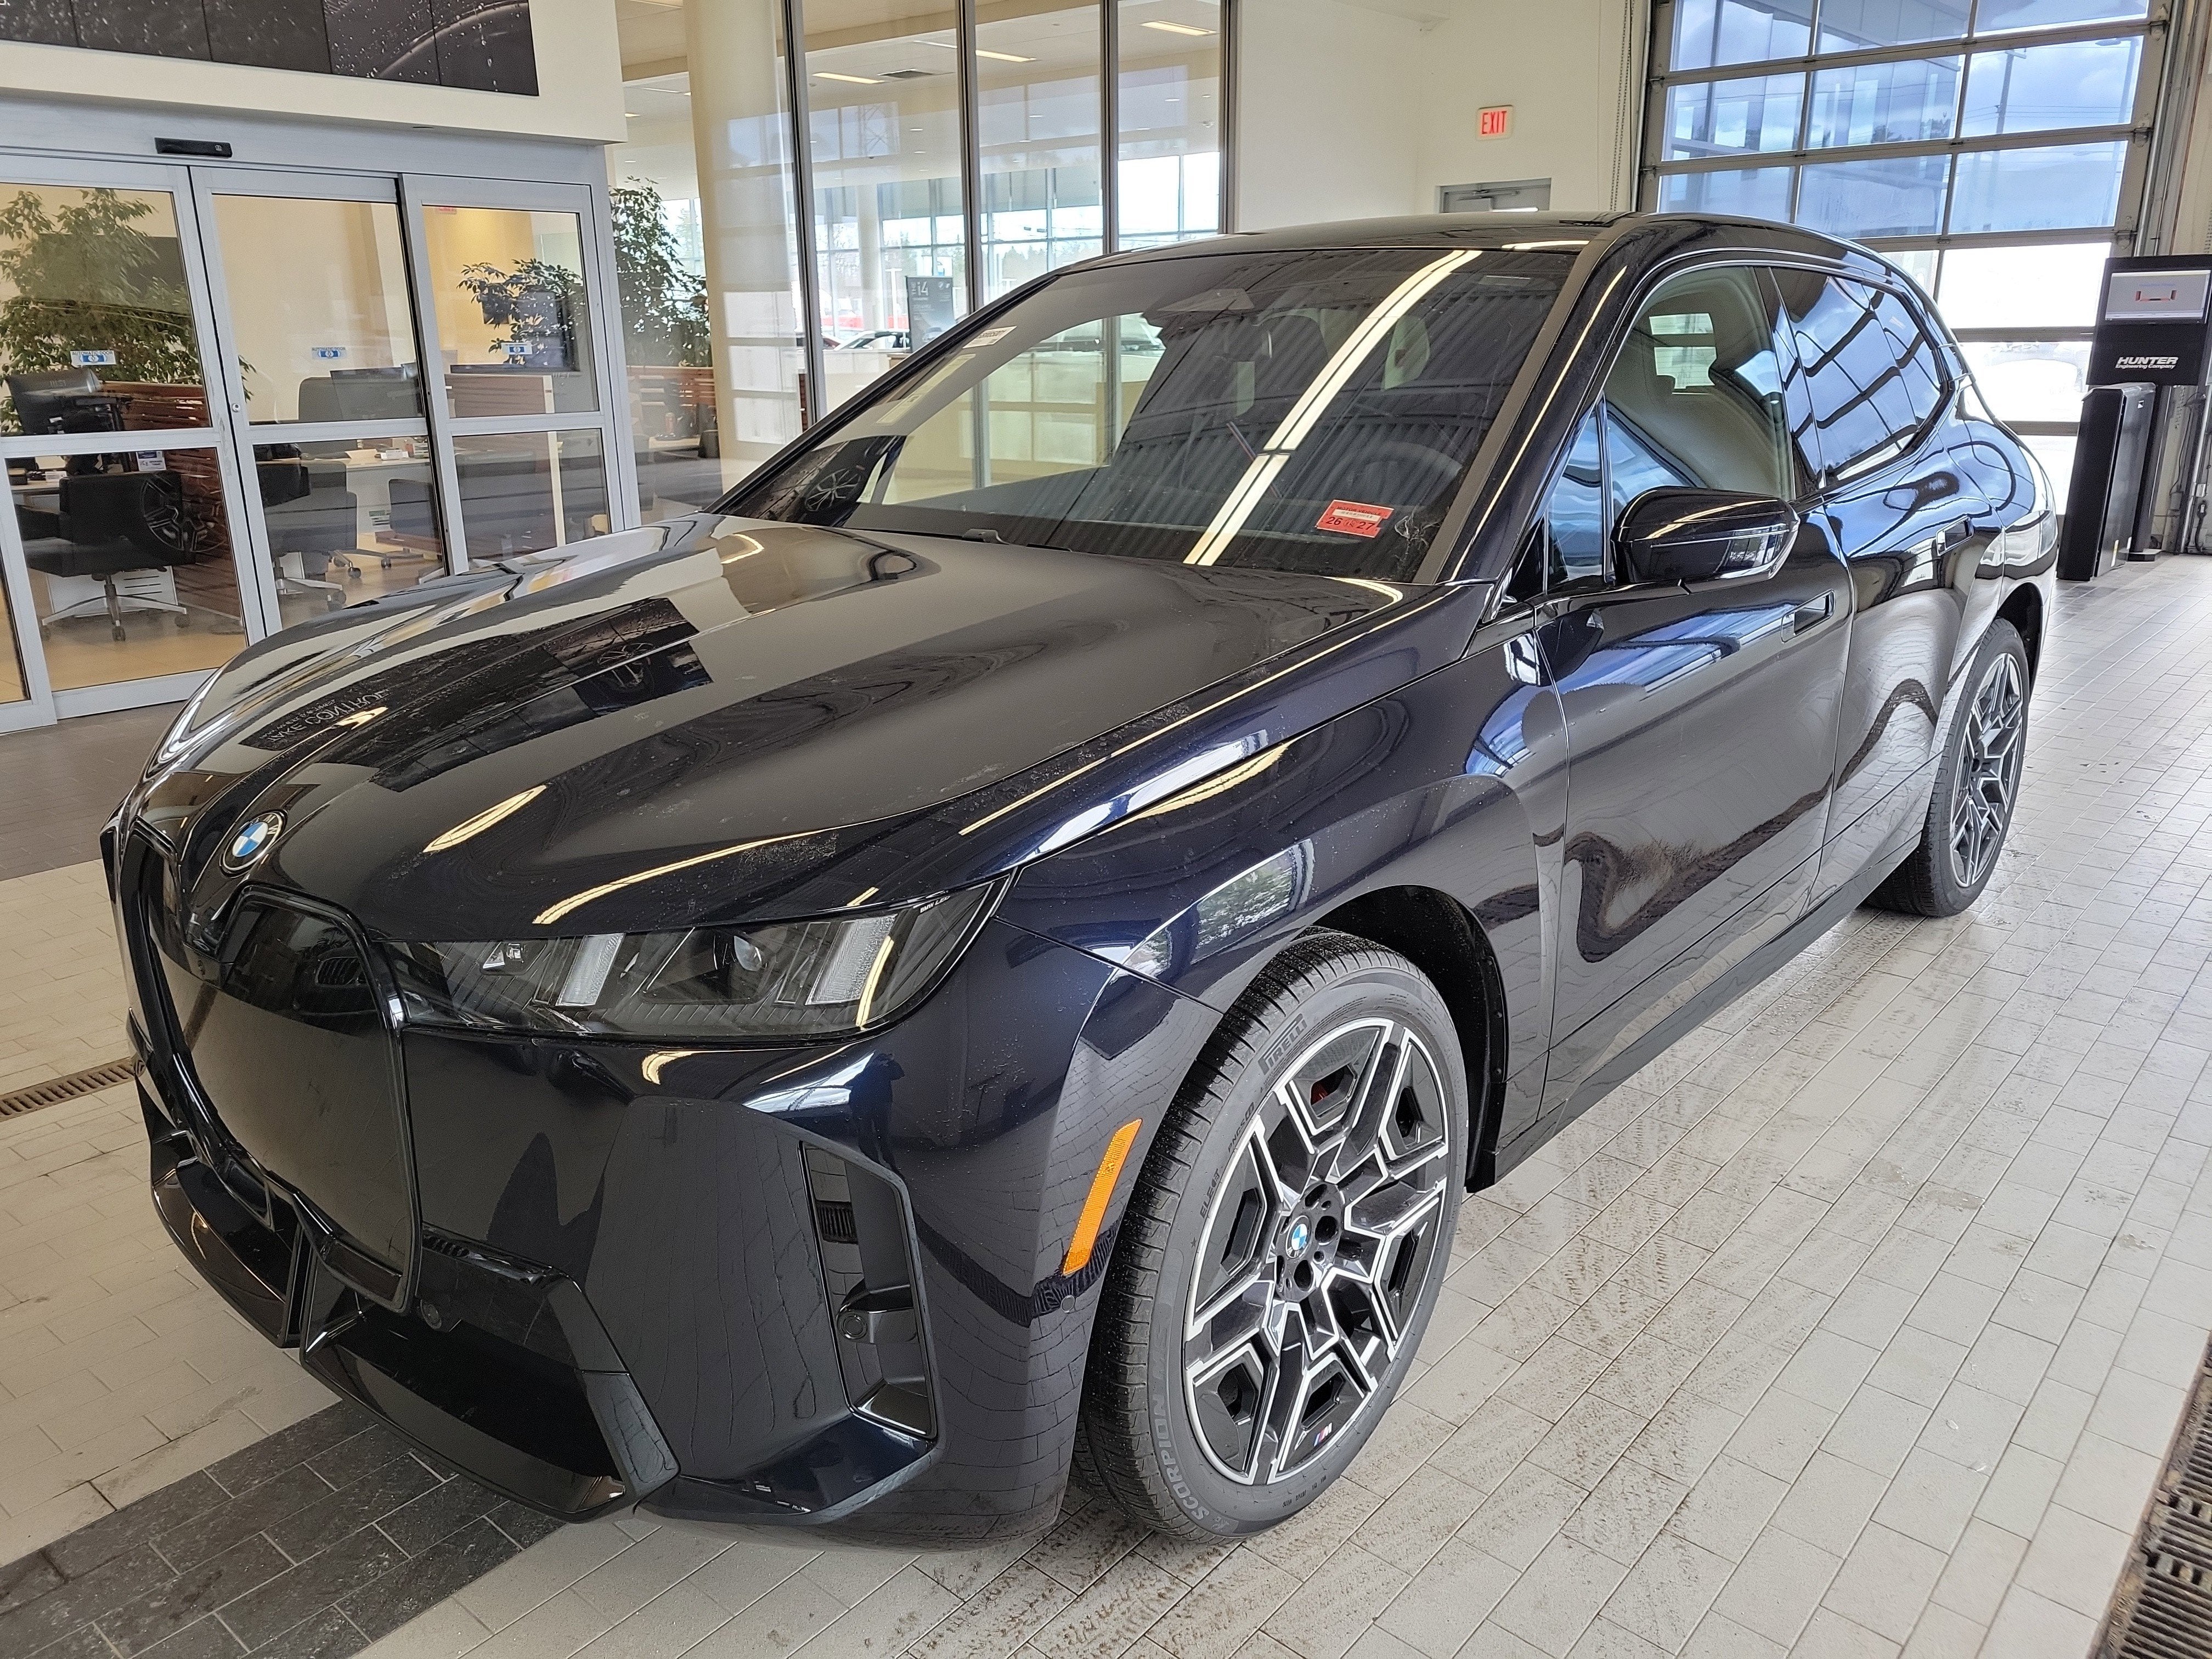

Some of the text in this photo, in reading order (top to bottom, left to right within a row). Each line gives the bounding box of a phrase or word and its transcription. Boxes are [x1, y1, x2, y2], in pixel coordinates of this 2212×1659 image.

[1482, 111, 1507, 134] EXIT
[917, 281, 929, 296] i4
[1325, 516, 1376, 531] 26 27
[919, 895, 951, 913] BMW LED
[1257, 1013, 1308, 1075] PIRELLI
[1153, 1395, 1210, 1520] SCORPION
